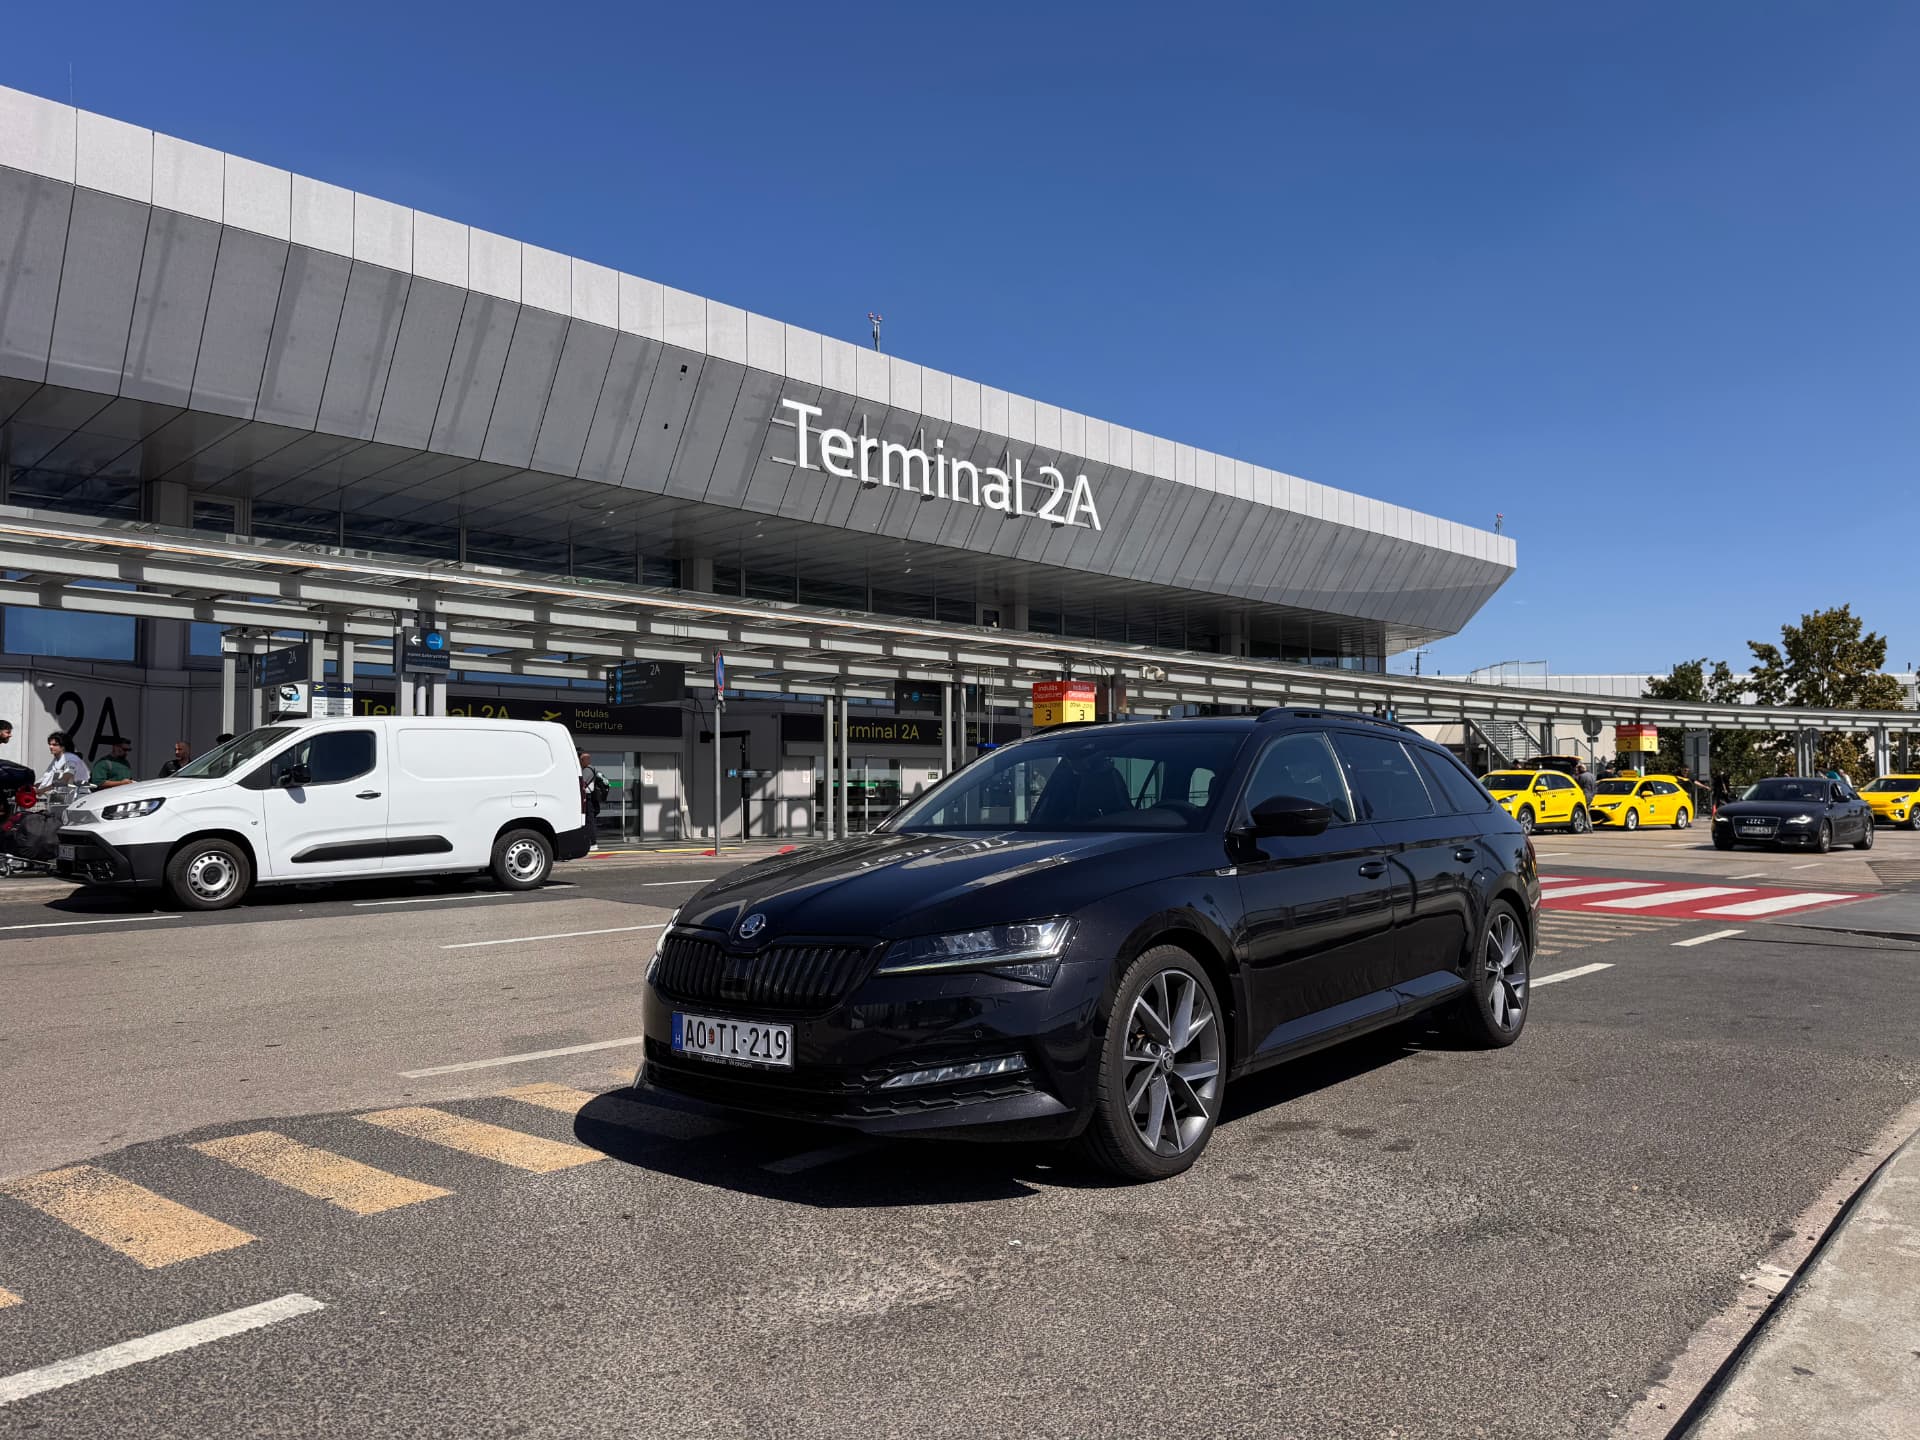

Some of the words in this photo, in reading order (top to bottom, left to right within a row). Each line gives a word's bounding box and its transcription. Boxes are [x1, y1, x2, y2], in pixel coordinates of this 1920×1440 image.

[782, 398, 1023, 515] Terminal
[1036, 466, 1102, 531] 2A
[649, 664, 661, 676] 2A
[1046, 710, 1052, 721] 3
[1079, 709, 1085, 721] 3
[55, 691, 121, 762] 2A
[833, 721, 897, 739] Trminal
[901, 723, 920, 740] 2A
